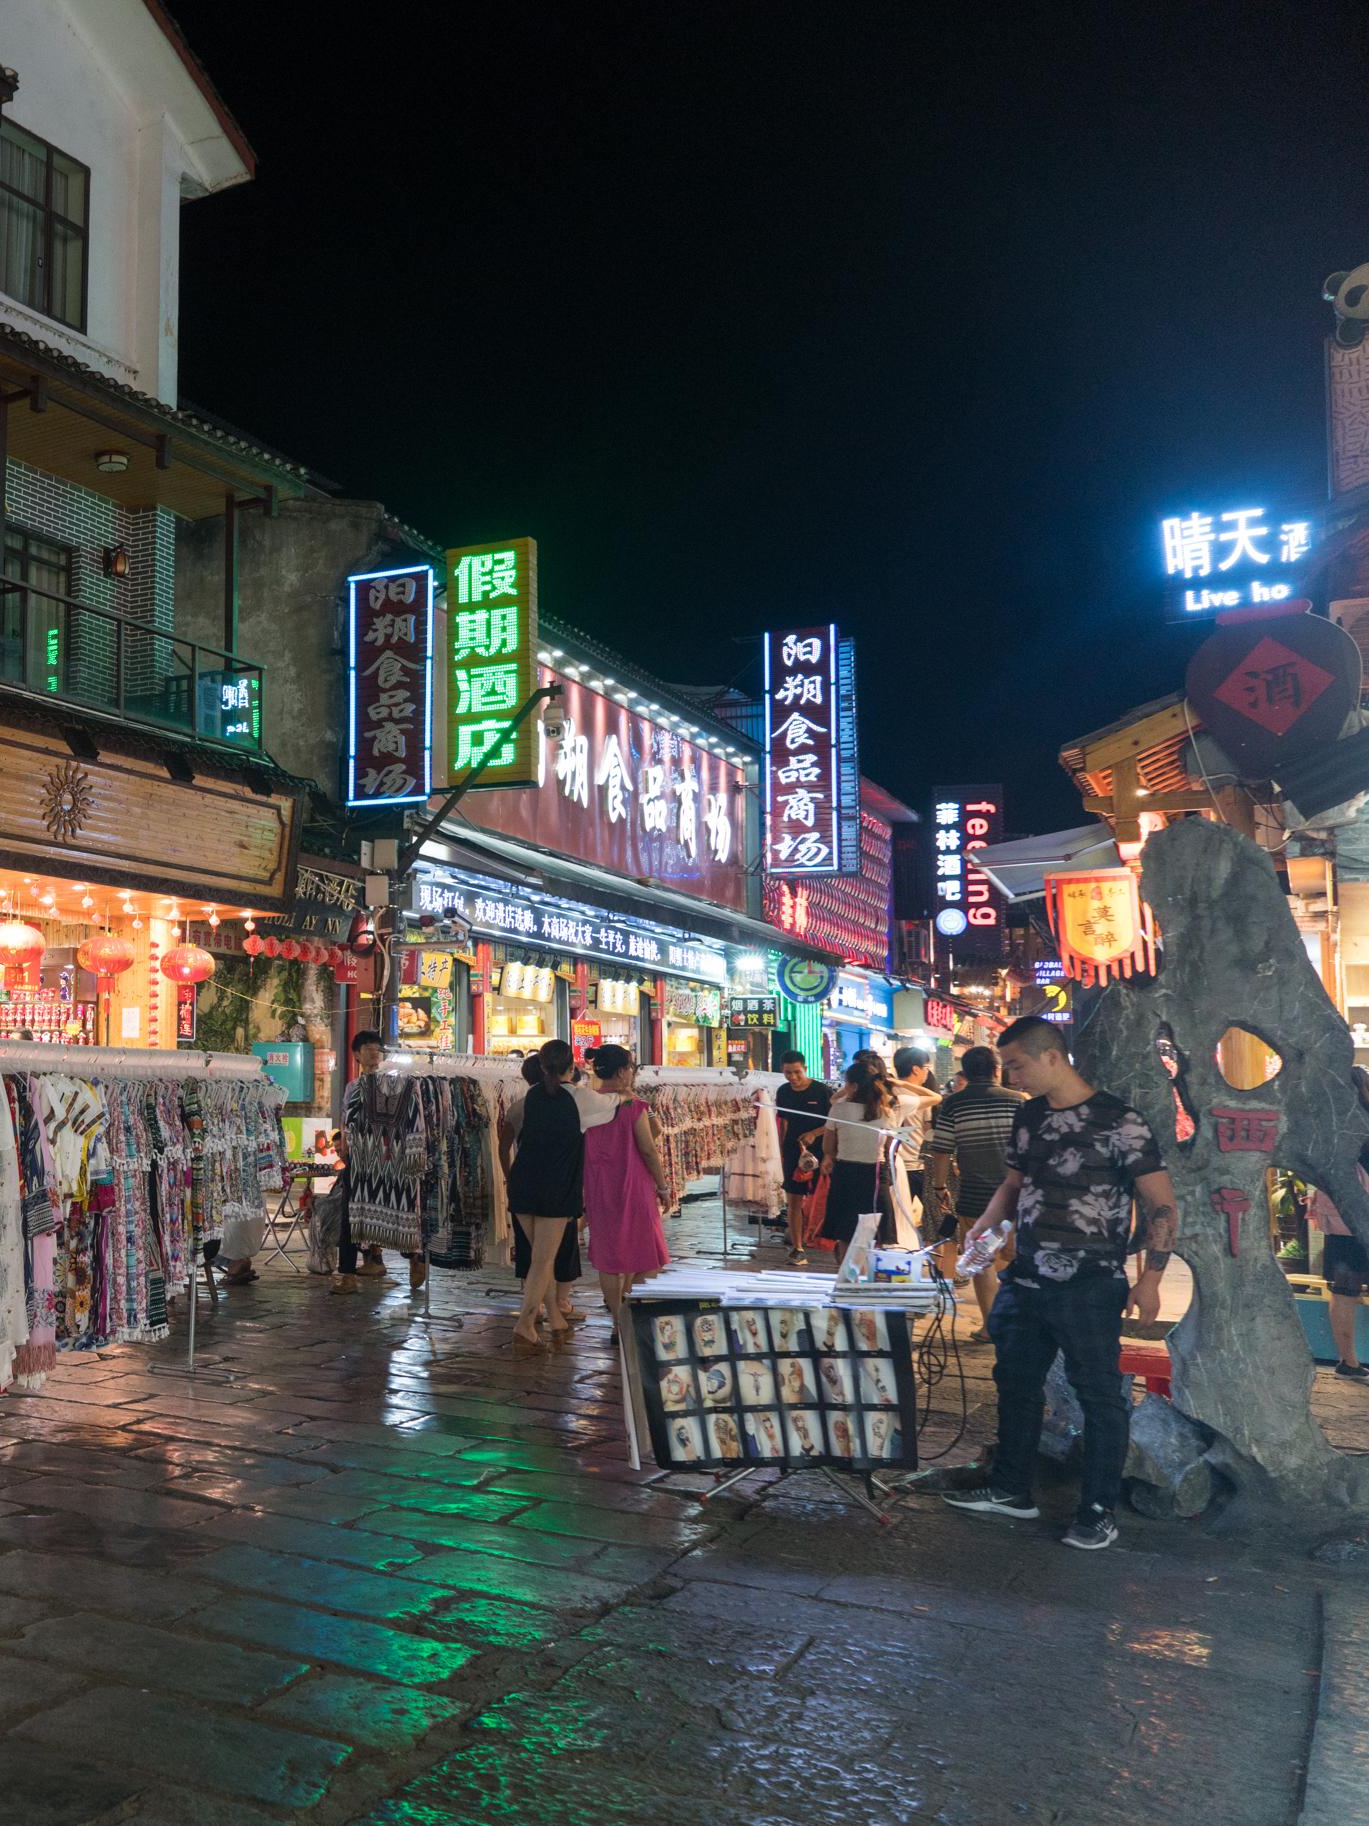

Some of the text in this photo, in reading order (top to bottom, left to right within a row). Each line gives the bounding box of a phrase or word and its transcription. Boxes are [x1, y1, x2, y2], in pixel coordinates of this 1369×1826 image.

[1184, 588, 1240, 612] Live
[361, 576, 418, 799] 阳朔食品商场
[453, 550, 519, 771] 假期酒店
[1242, 661, 1303, 710] 酒
[537, 717, 731, 863] 朔食品商场
[771, 633, 831, 867] 阳朔食品商场
[935, 802, 962, 901] 菲林酒吧
[965, 801, 997, 926] feeing
[420, 957, 449, 982] 特产
[731, 999, 775, 1011] 烟酒茶
[747, 1013, 775, 1025] 饮料
